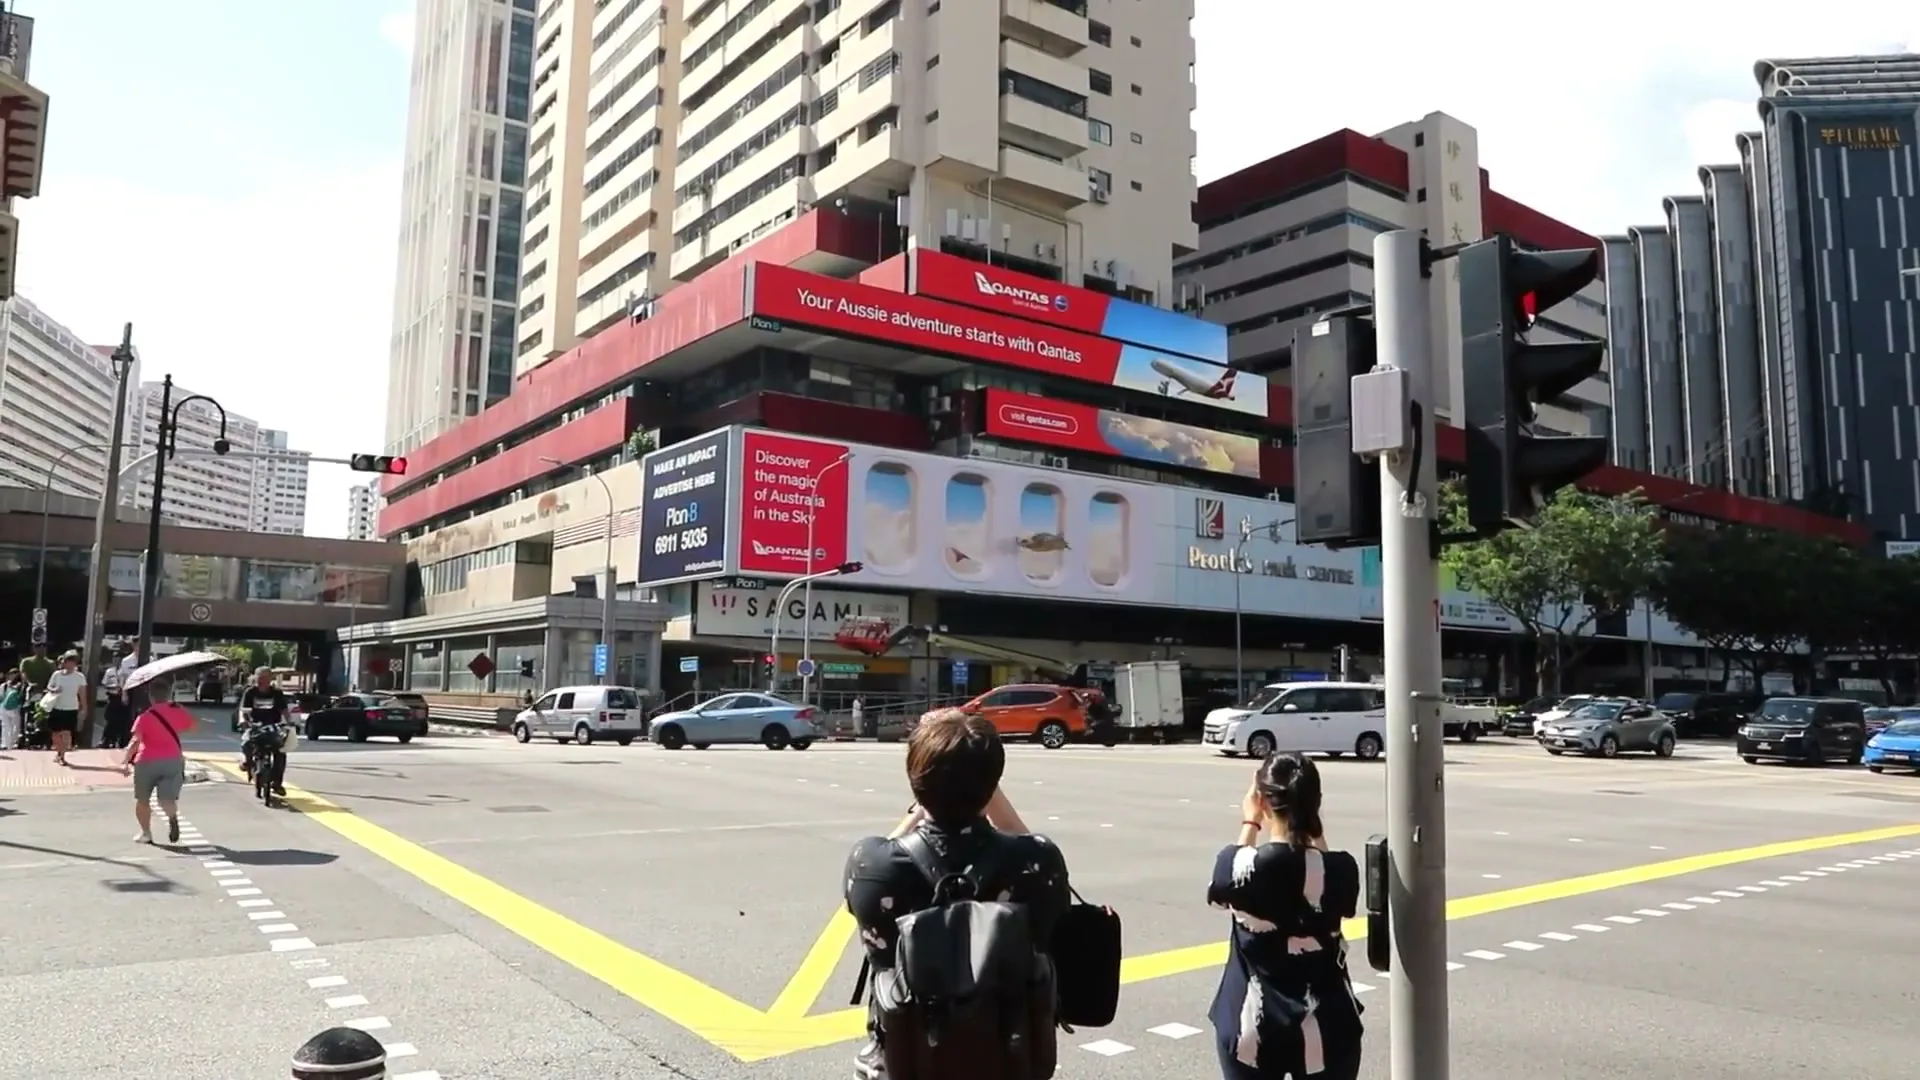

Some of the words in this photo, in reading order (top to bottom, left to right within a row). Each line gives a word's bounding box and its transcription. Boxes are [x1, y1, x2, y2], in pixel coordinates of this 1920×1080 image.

[992, 282, 1049, 305] QANTAS
[797, 287, 833, 310] Your
[836, 297, 888, 322] Aussie
[891, 311, 963, 338] adventure
[965, 327, 1005, 347] starts
[1008, 335, 1035, 353] with
[1037, 341, 1082, 364] Qantas
[1026, 415, 1068, 429] qantas.com
[653, 459, 674, 476] MAKE
[675, 454, 687, 469] AN
[688, 445, 717, 465] IMPACT
[755, 449, 811, 469] Discover
[653, 477, 693, 500] ADVERTISE
[694, 471, 716, 489] HERE
[754, 469, 776, 484] the
[778, 474, 817, 490] magic
[754, 488, 768, 502] of
[770, 489, 825, 508] Austraia
[753, 506, 766, 520] in
[769, 508, 789, 522] the
[792, 510, 816, 526] Sky
[655, 533, 678, 556] 6911
[681, 527, 708, 550] 5035
[767, 545, 811, 557] QANTAS
[747, 596, 863, 622] SAGAMI
